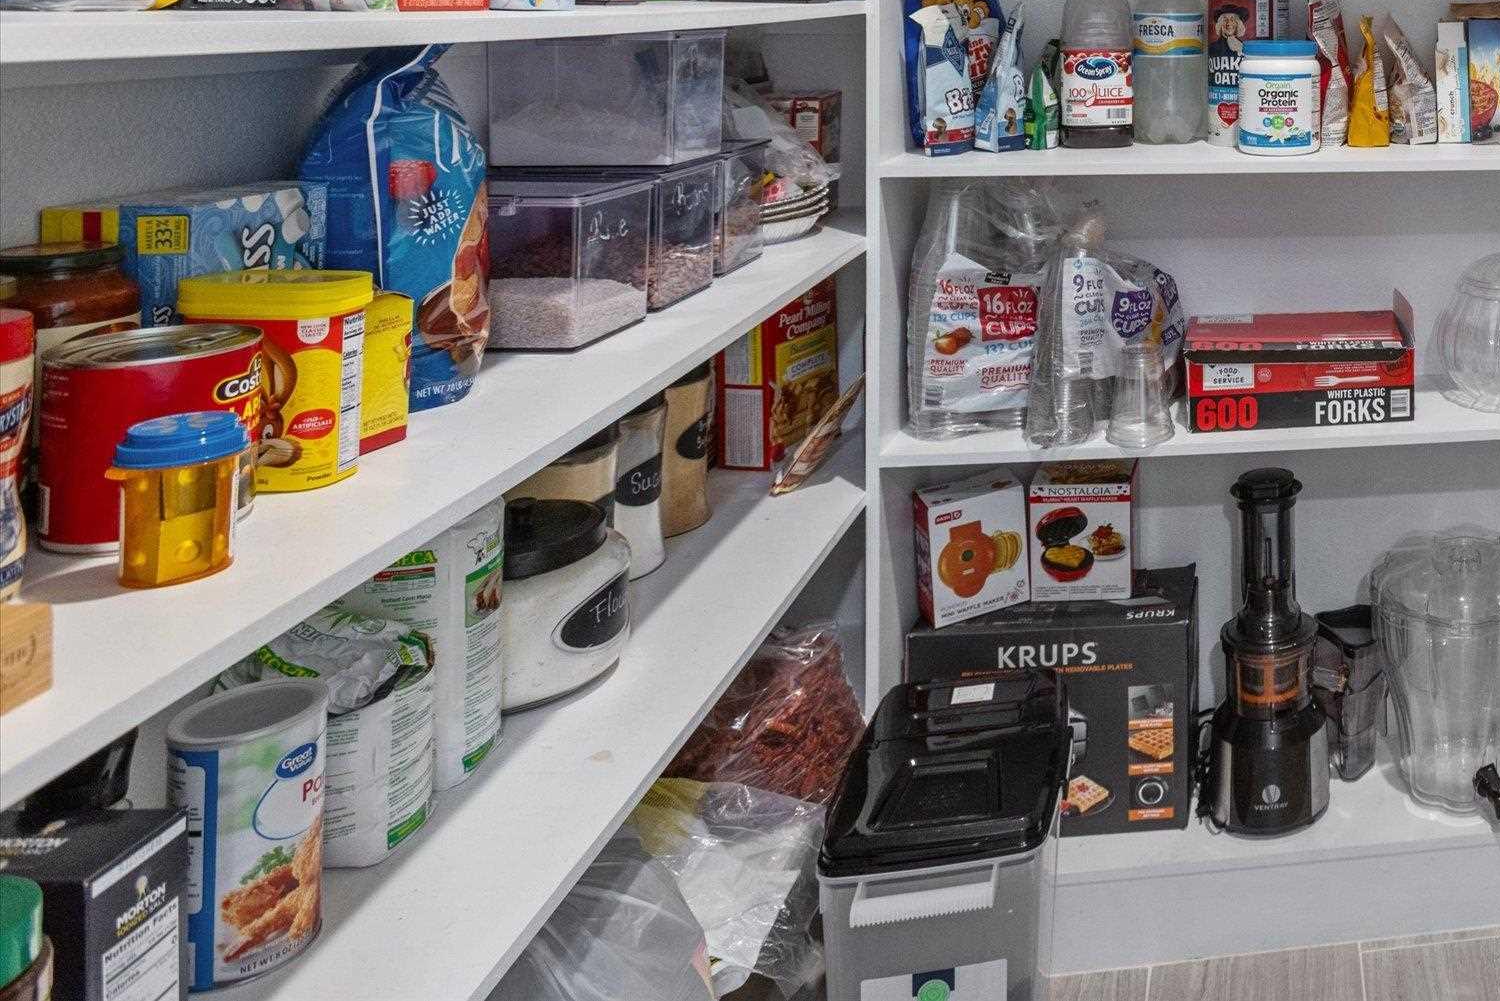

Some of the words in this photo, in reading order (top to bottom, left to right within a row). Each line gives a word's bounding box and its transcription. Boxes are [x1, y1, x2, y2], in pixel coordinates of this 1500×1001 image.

[1139, 24, 1174, 37] FRESCA
[1078, 64, 1096, 75] Ocean
[1096, 65, 1112, 76] Spray
[1208, 56, 1240, 73] QUAK
[1215, 72, 1240, 85] OAT
[1069, 88, 1087, 98] 100
[1258, 89, 1299, 100] Organic
[422, 200, 449, 219] JUST
[429, 208, 453, 223] ADD
[423, 211, 460, 238] WATER
[1072, 274, 1085, 292] 9
[985, 295, 1005, 313] 16
[1119, 297, 1129, 312] 9
[981, 365, 1032, 376] PREMIUM
[981, 374, 1031, 384] QUALITY
[1213, 376, 1245, 384] SERVICE
[416, 388, 433, 400] NET
[1327, 390, 1353, 399] WHITE
[1354, 388, 1386, 398] PLASTIC
[1196, 396, 1258, 432] 600
[1314, 398, 1385, 425] FORKS
[1048, 487, 1112, 496] NOSTALGIA
[1126, 608, 1175, 620] KRUPS
[997, 641, 1098, 669] KRUPS
[1108, 663, 1134, 671] PLATES
[282, 748, 313, 770] Great
[116, 882, 167, 928] MORTON
[104, 931, 149, 964] Nutrition
[240, 962, 257, 975] NET
